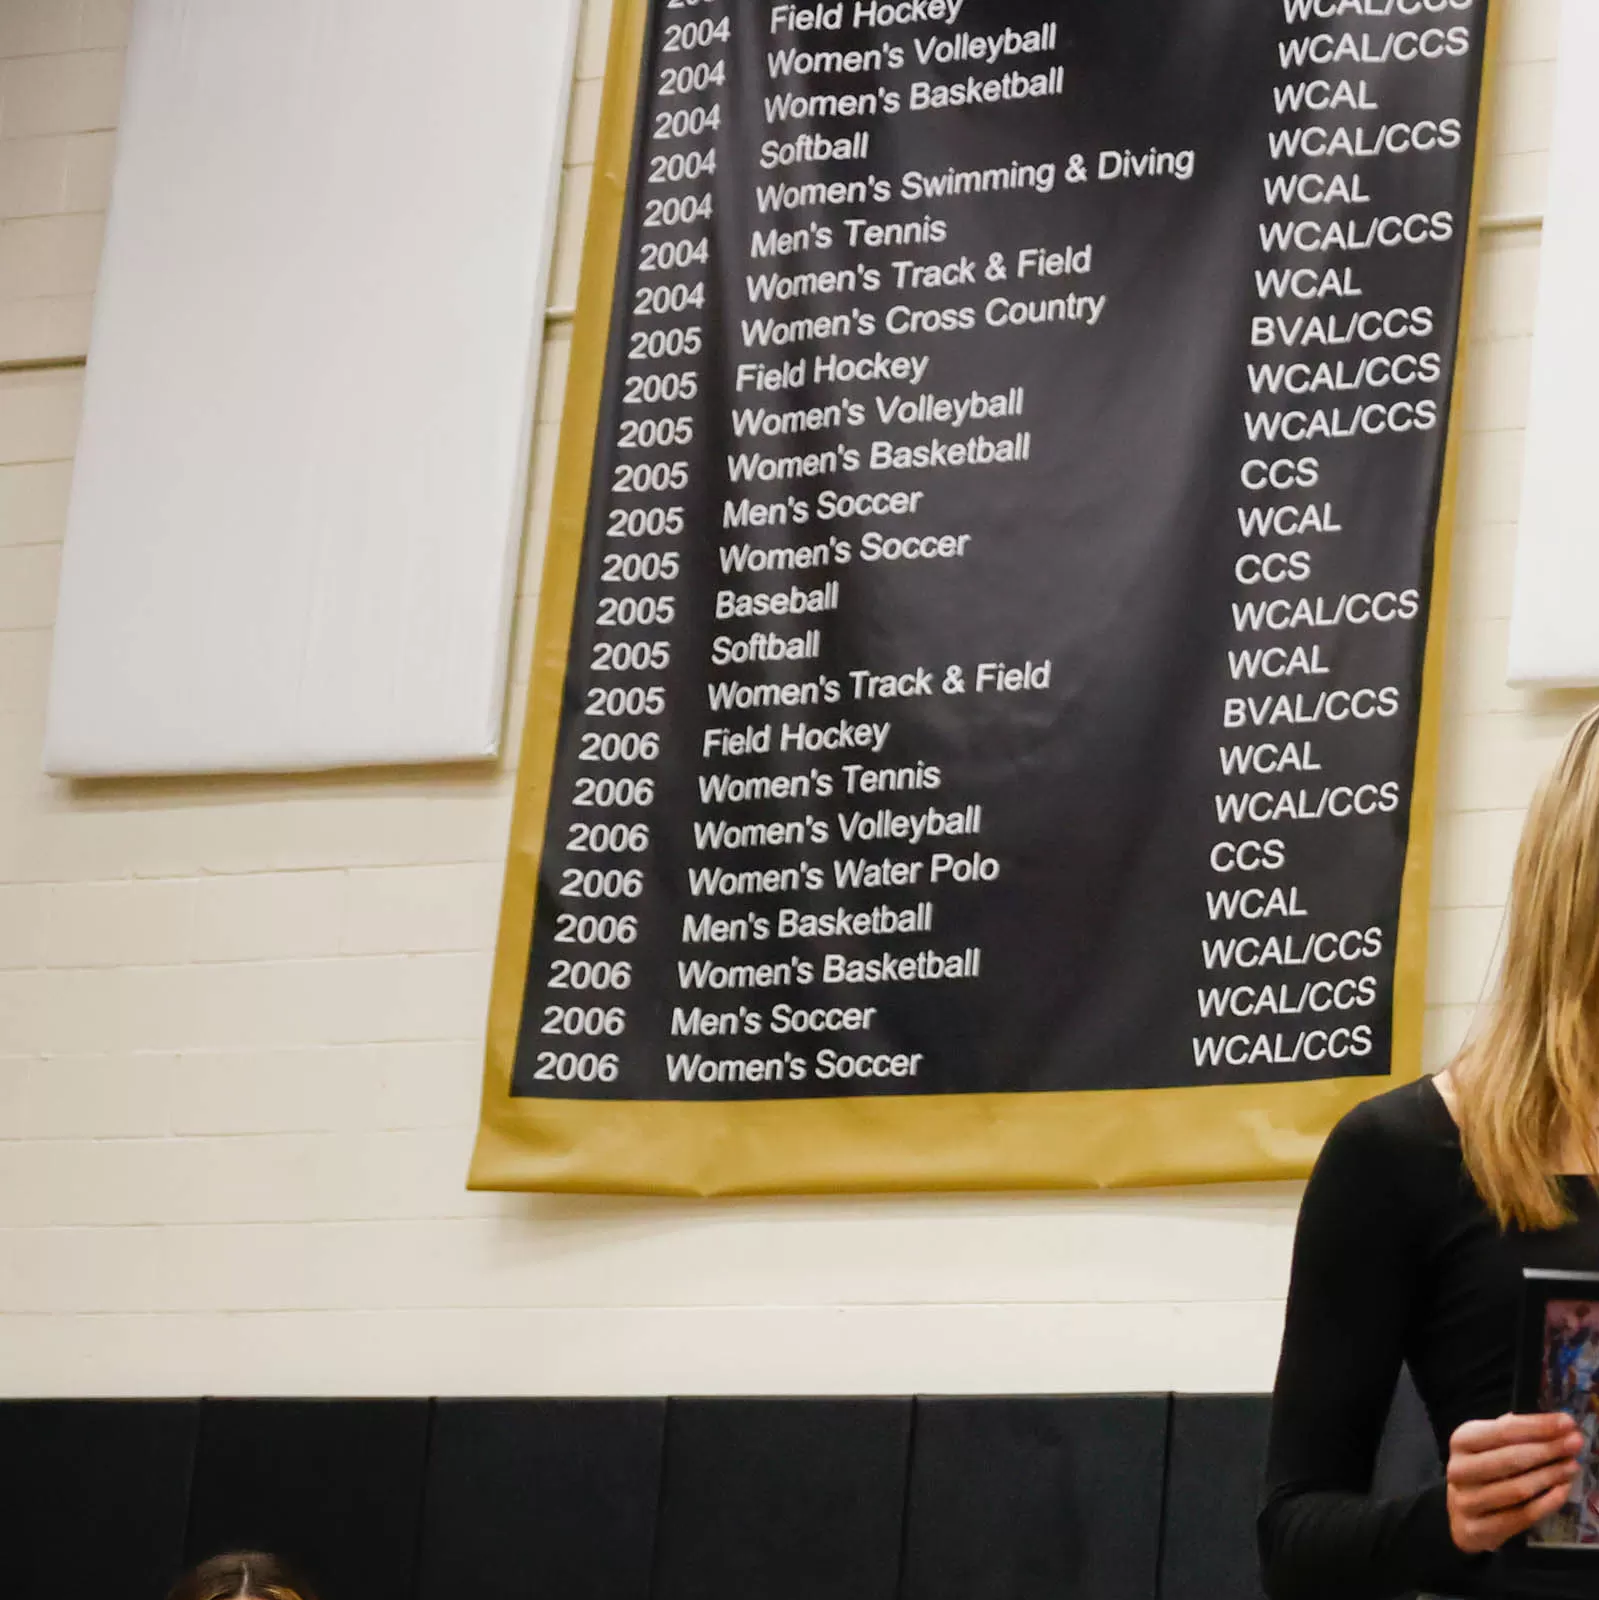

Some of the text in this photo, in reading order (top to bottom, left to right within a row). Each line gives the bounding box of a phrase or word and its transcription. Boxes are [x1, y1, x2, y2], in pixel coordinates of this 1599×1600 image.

[658, 59, 725, 95] 2004
[768, 42, 904, 78] Women's
[914, 22, 1056, 64] Volleyball
[663, 0, 963, 52] 2004 Field Hockey
[653, 26, 1469, 139] 2004 Women's Basketball WCAL/CCS
[648, 80, 1378, 183] 2004 Softball WCAL
[643, 118, 1461, 227] 2004 Women's Swimming & Diving WCAL/CCS
[639, 174, 1370, 271] 2004 Men's Tennis WCAL
[633, 211, 1453, 315] 2004 Women's Track & Field WCAL/CCS
[628, 267, 1362, 359] 2005 Women's Cross Country WCAL
[623, 306, 1433, 403] 2005 Field Hockey BVAL/CCS
[617, 352, 1441, 448] 2005 Women's Volleyball WCAL/CCS
[612, 400, 1437, 492] 2005 Women's Basketball WCAL/CCS
[606, 457, 1319, 537] 2005 Men's Soccer CCS
[600, 502, 1341, 582] 2005 Women's Soccer WCAL
[596, 551, 1311, 626] 2005 Baseball CCS
[590, 589, 1419, 671] 2005 Softball WCAL/CCS
[584, 645, 1329, 716] 2005 Women's Track & Field WCAL
[578, 687, 1399, 761] 2006 Field Hockey BVAL/CCS
[572, 741, 1321, 807] 2006 Women's Tennis WCAL
[566, 781, 1399, 852] 2006 Women's Volleyball WCAL/CCS
[559, 839, 1285, 898] 2006 Women's Water Polo CCS
[554, 886, 1308, 944] 2006 Men's Basketball WCAL
[547, 927, 1382, 990] 2006 Women's Basketball WCAL/CCS
[541, 976, 1377, 1036] 2006 Men's Soccer WCAL/CCS
[533, 1025, 1372, 1082] 2006 Women's Soccer WCAL/CCS
